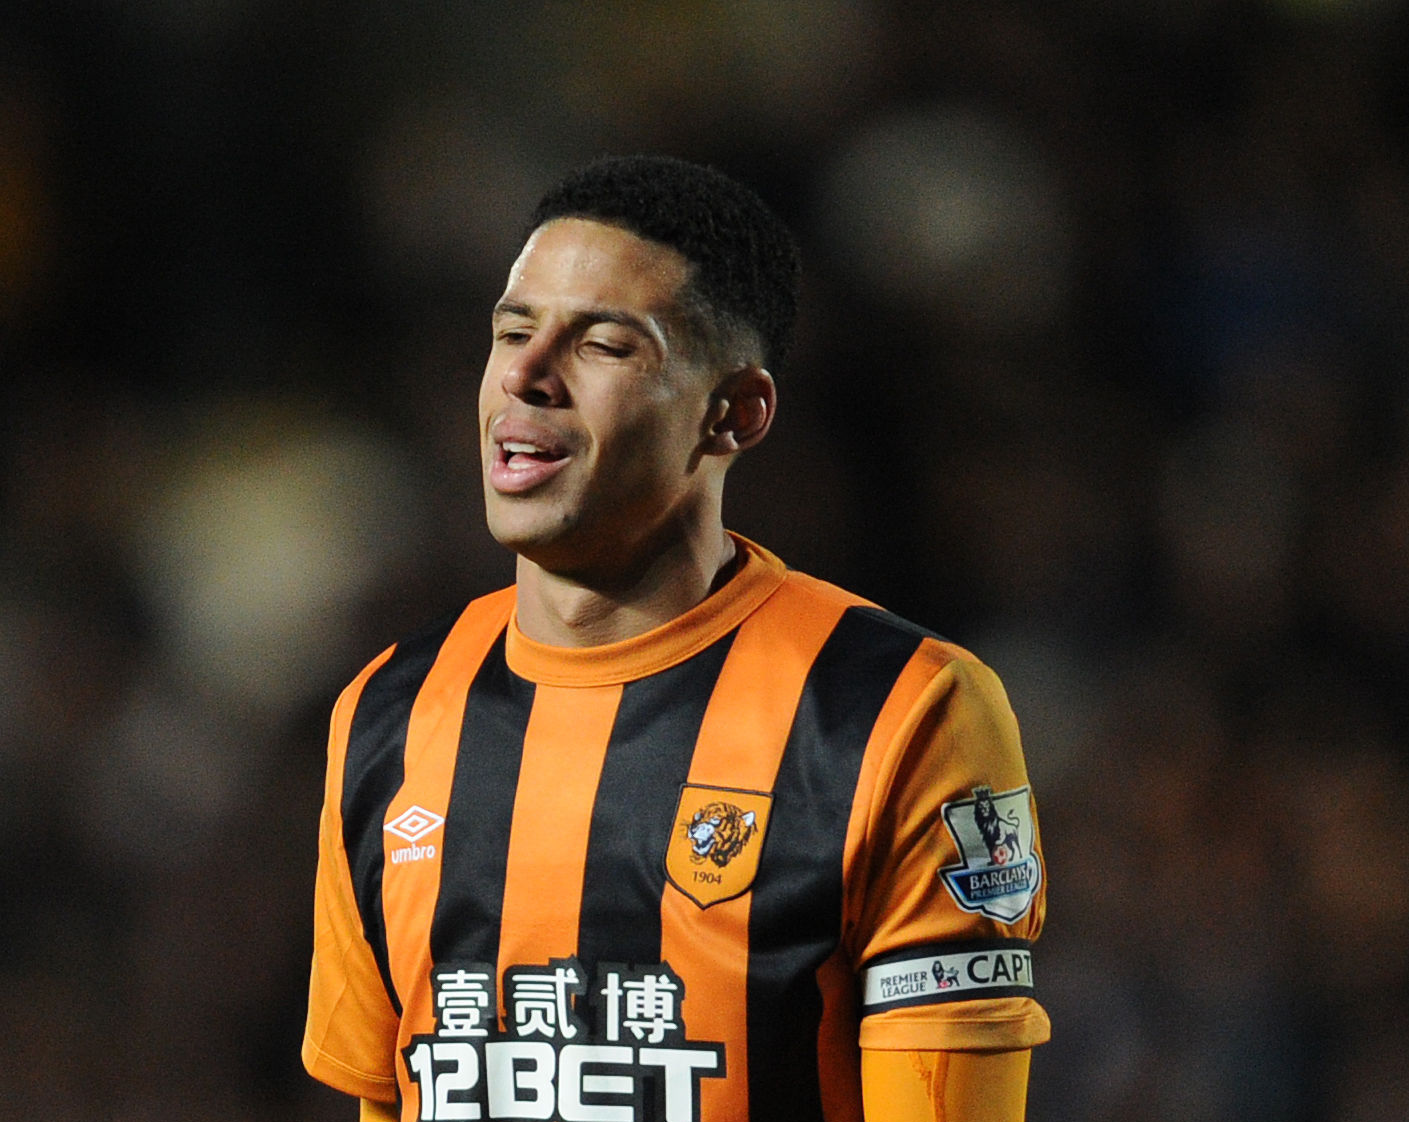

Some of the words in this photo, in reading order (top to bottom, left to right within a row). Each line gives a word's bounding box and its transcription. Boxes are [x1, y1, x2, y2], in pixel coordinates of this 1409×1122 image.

[391, 843, 436, 864] umbro
[693, 871, 722, 885] 1904
[969, 866, 1026, 890] BARCLAYS
[880, 971, 928, 988] PREMIER
[882, 982, 926, 999] LEAGUE
[437, 968, 678, 1044] 壹贰博
